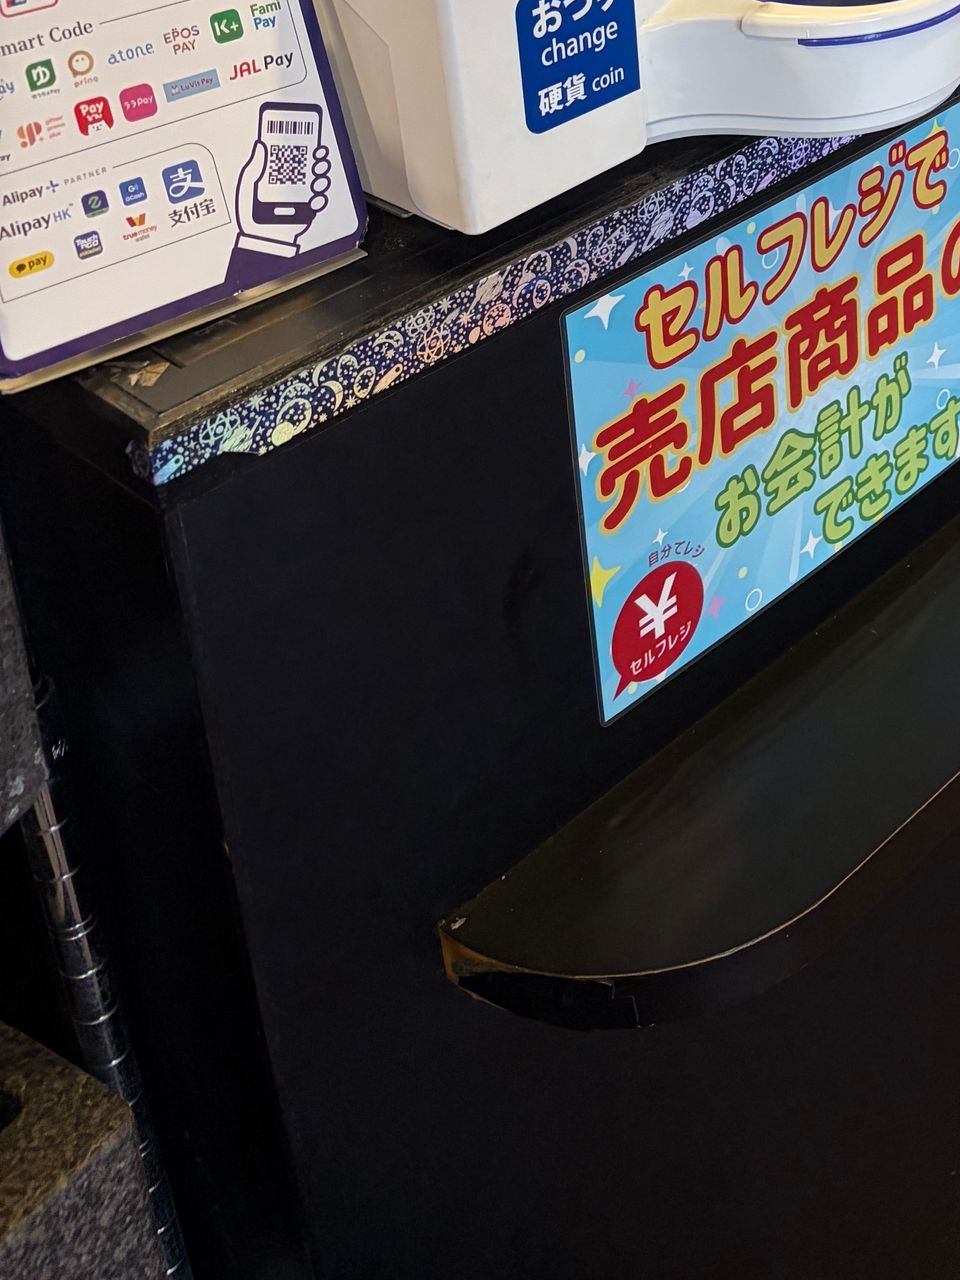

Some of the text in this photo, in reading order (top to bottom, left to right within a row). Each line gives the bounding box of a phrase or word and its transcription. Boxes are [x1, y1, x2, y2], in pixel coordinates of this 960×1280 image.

[49, 19, 95, 44] Code
[253, 16, 277, 31] Pay
[108, 42, 155, 65] atone
[172, 38, 197, 56] PAY
[541, 21, 618, 67] change
[230, 52, 294, 81] JAL Pay
[74, 76, 99, 88] pring
[538, 67, 625, 117] 硬貨 coin
[80, 101, 104, 116] Pay
[63, 167, 108, 186] PARTNER
[168, 198, 216, 228] 支付宝
[634, 128, 951, 370] セルフレジで
[28, 255, 48, 271] pay
[713, 352, 912, 549] お会計が
[629, 618, 693, 679] セルフレジ
